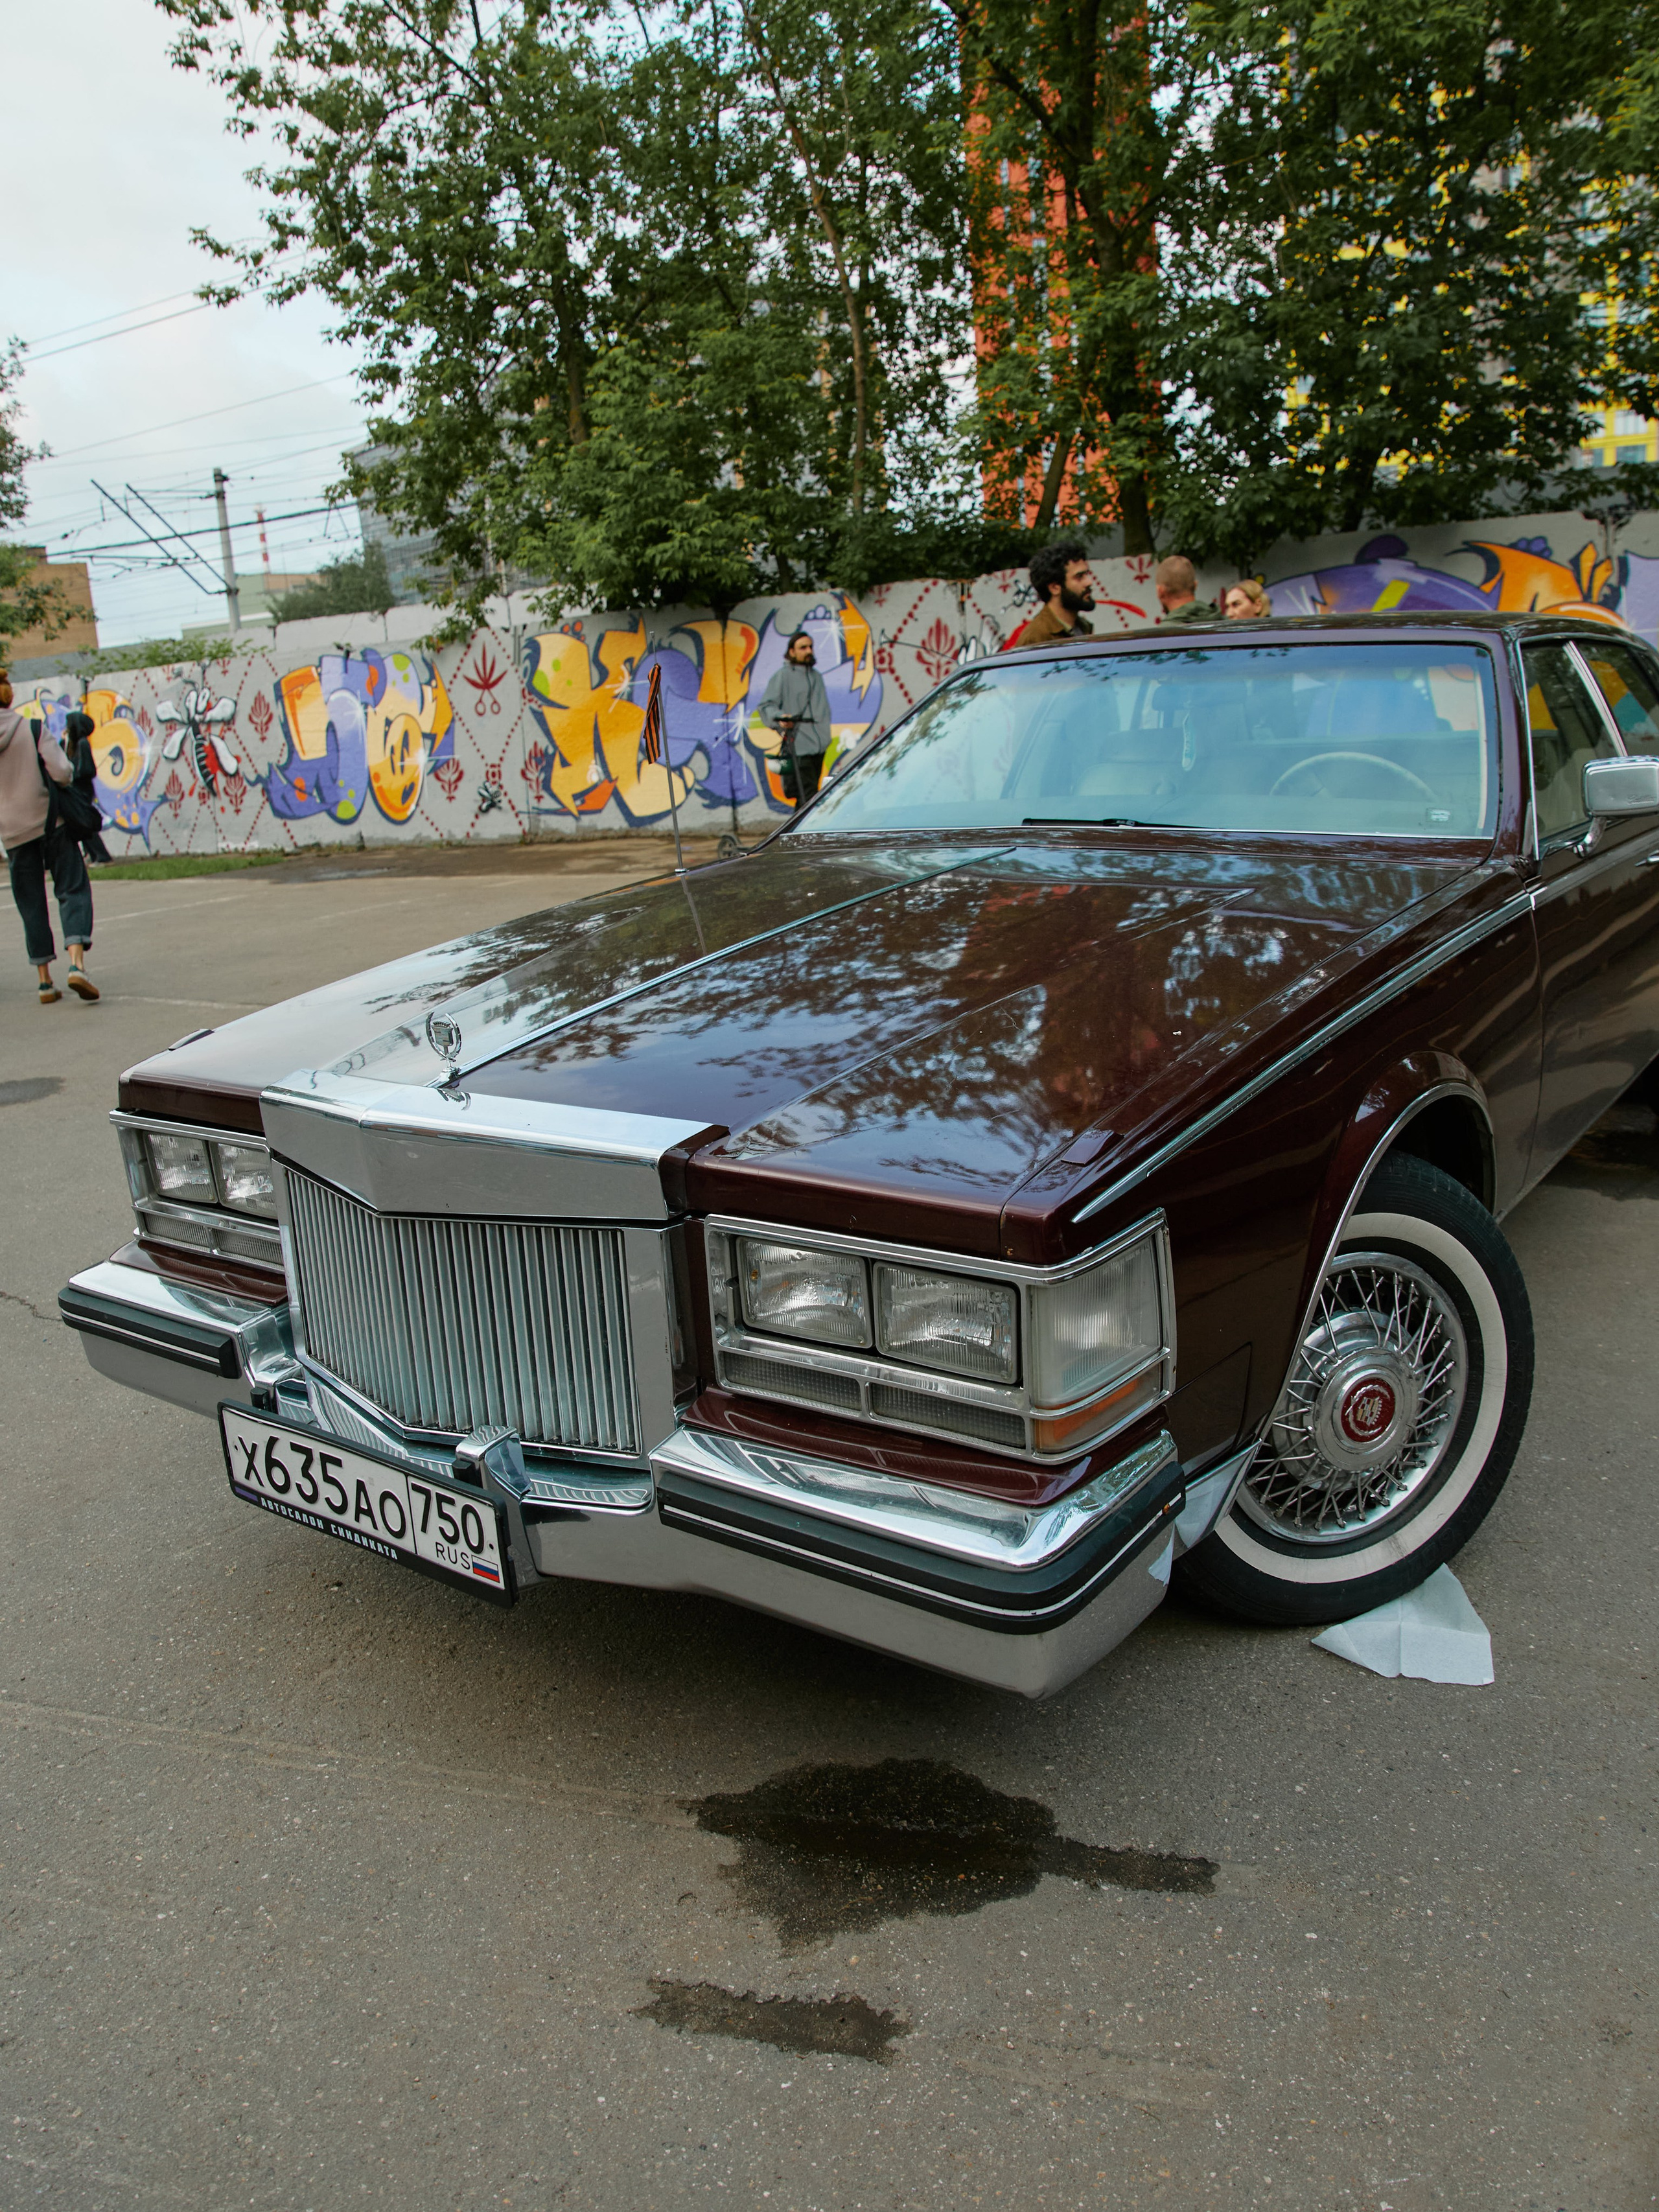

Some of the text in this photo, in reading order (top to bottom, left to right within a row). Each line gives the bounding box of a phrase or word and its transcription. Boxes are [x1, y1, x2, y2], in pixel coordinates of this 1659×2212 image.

[261, 1496, 398, 1561] АВТОСАЛОН СИНДИКАТА
[411, 1482, 484, 1555] 750
[435, 1541, 471, 1570] RUS
